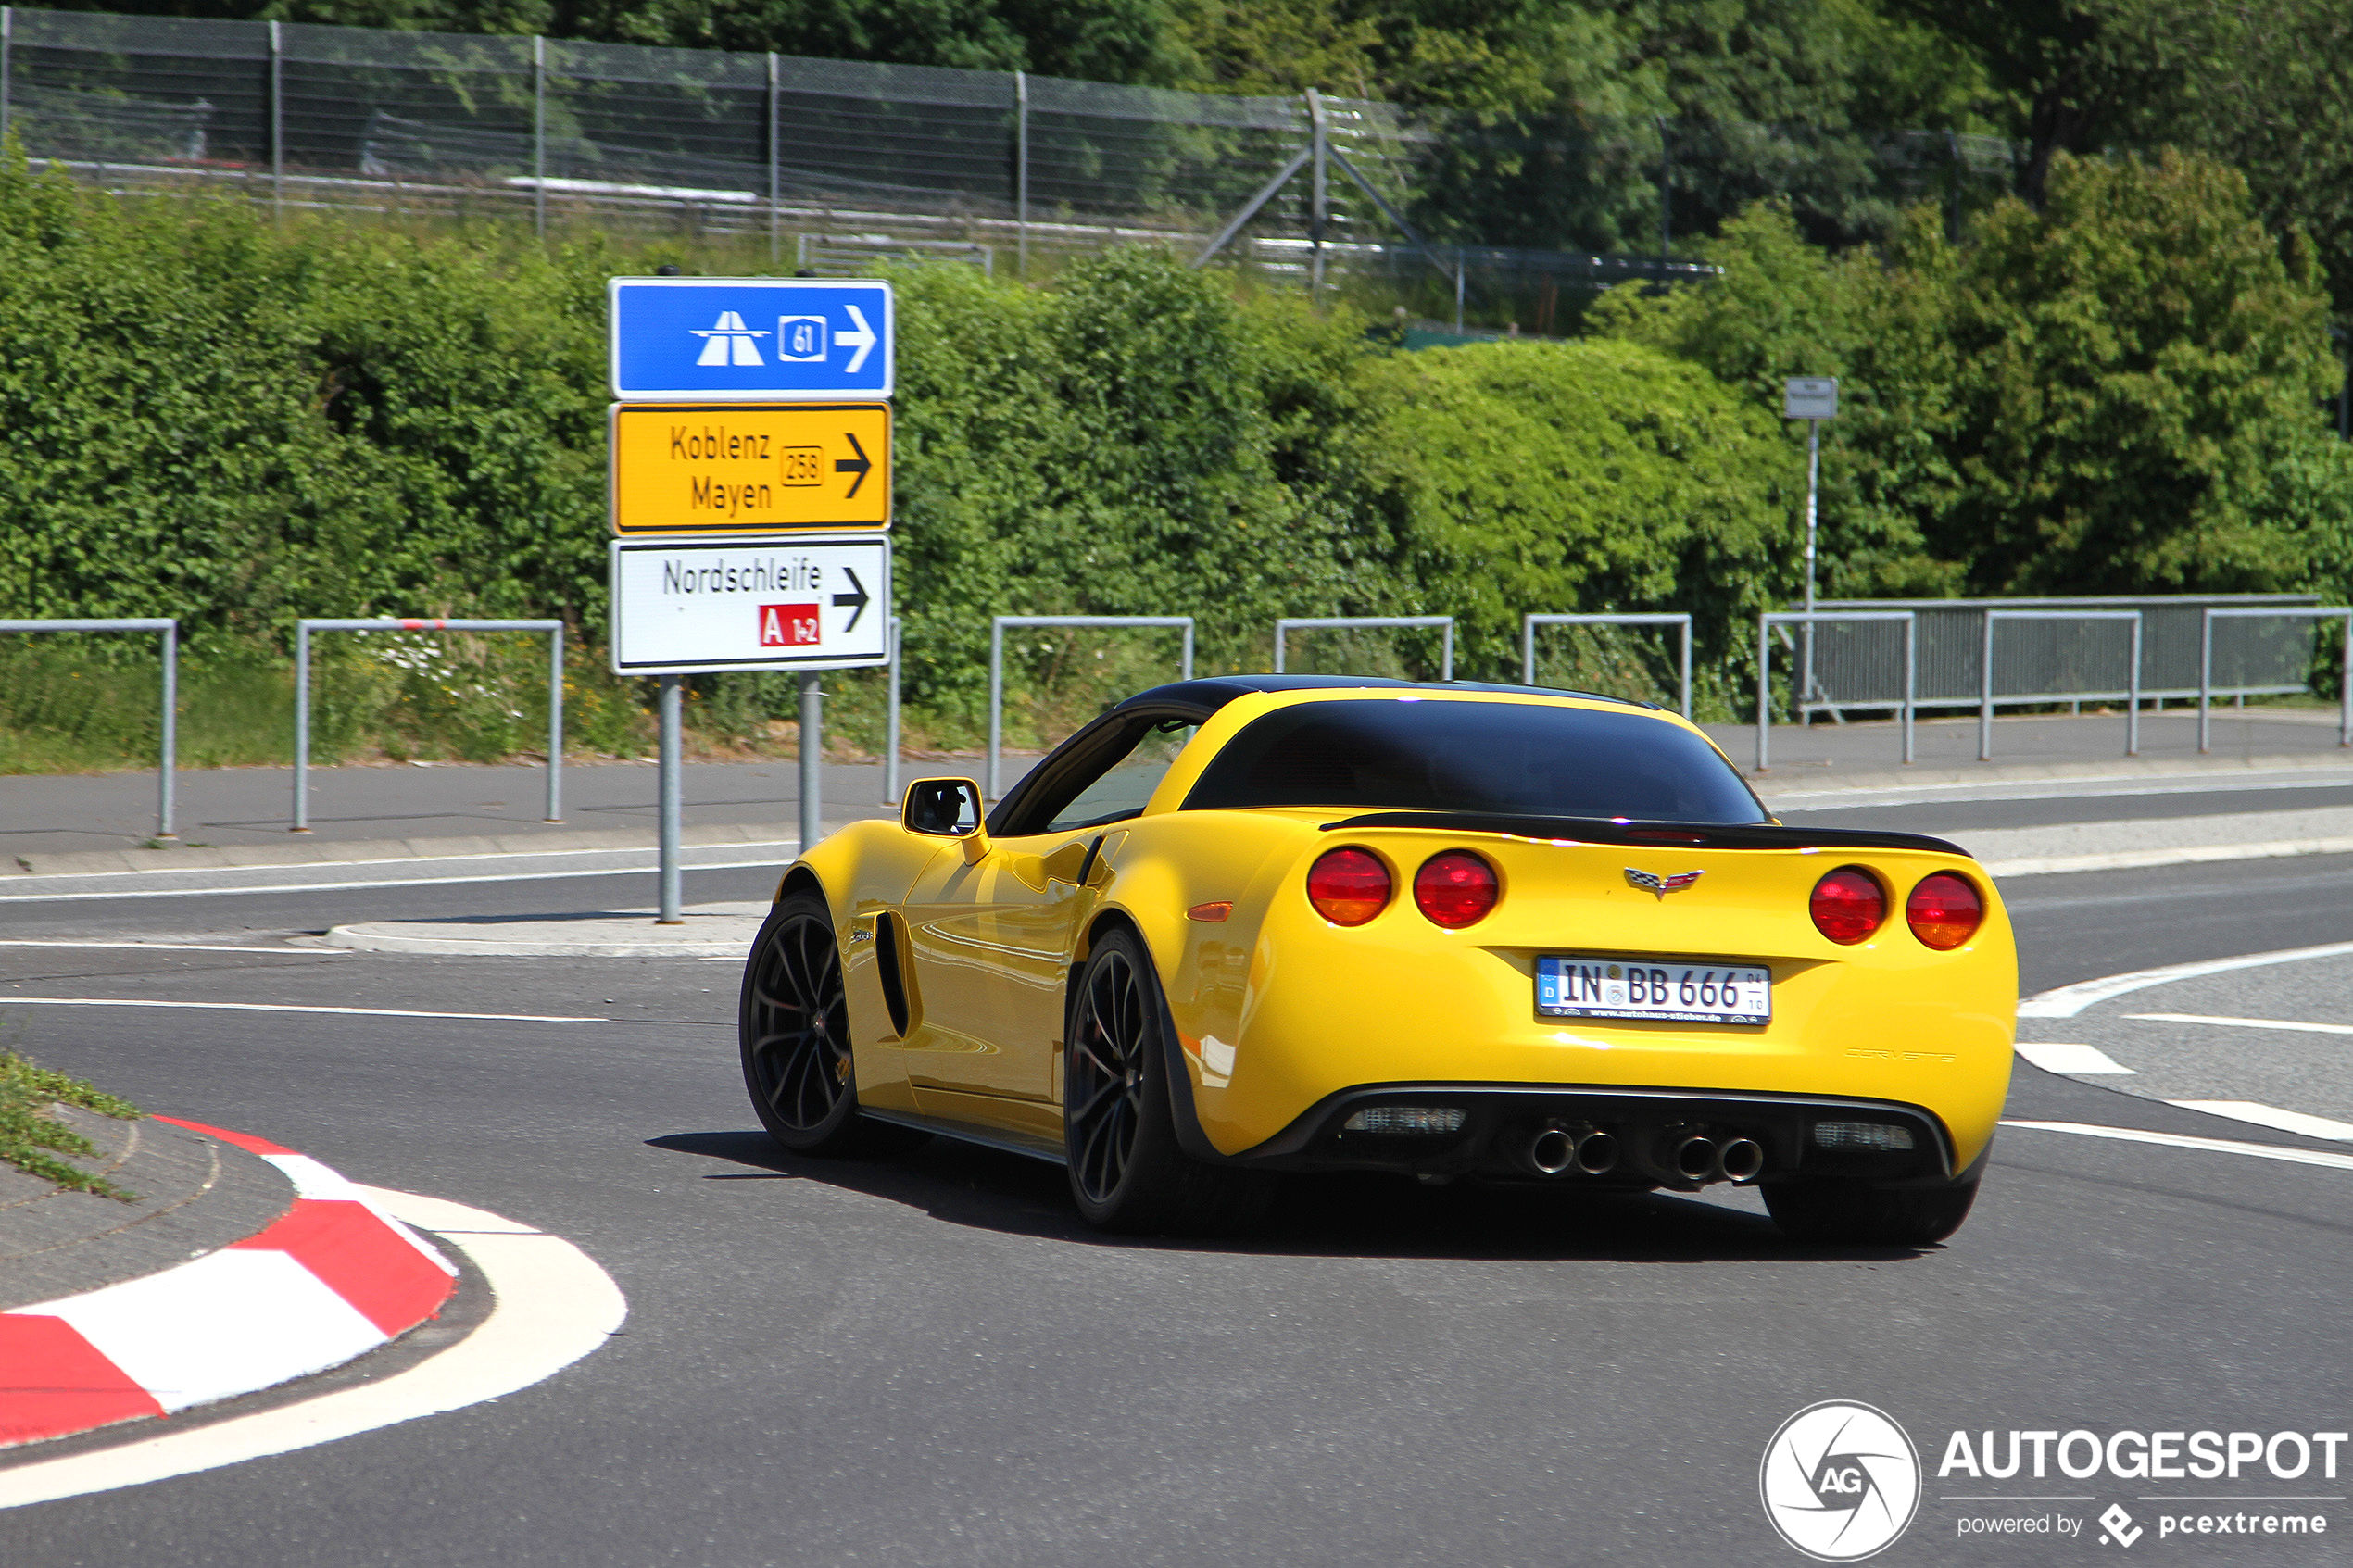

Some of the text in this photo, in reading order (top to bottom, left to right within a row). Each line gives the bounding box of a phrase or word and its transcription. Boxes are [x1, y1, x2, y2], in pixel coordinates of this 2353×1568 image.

[792, 324, 813, 353] 61
[670, 425, 819, 480] Koblenz 258
[691, 475, 772, 519] Mayen
[663, 557, 822, 595] Nordschleife
[762, 608, 785, 644] A
[1544, 986, 1555, 998] D
[1564, 964, 1740, 1009] IN BB 666
[1590, 1009, 1722, 1022] www.autohaus-stieber.de
